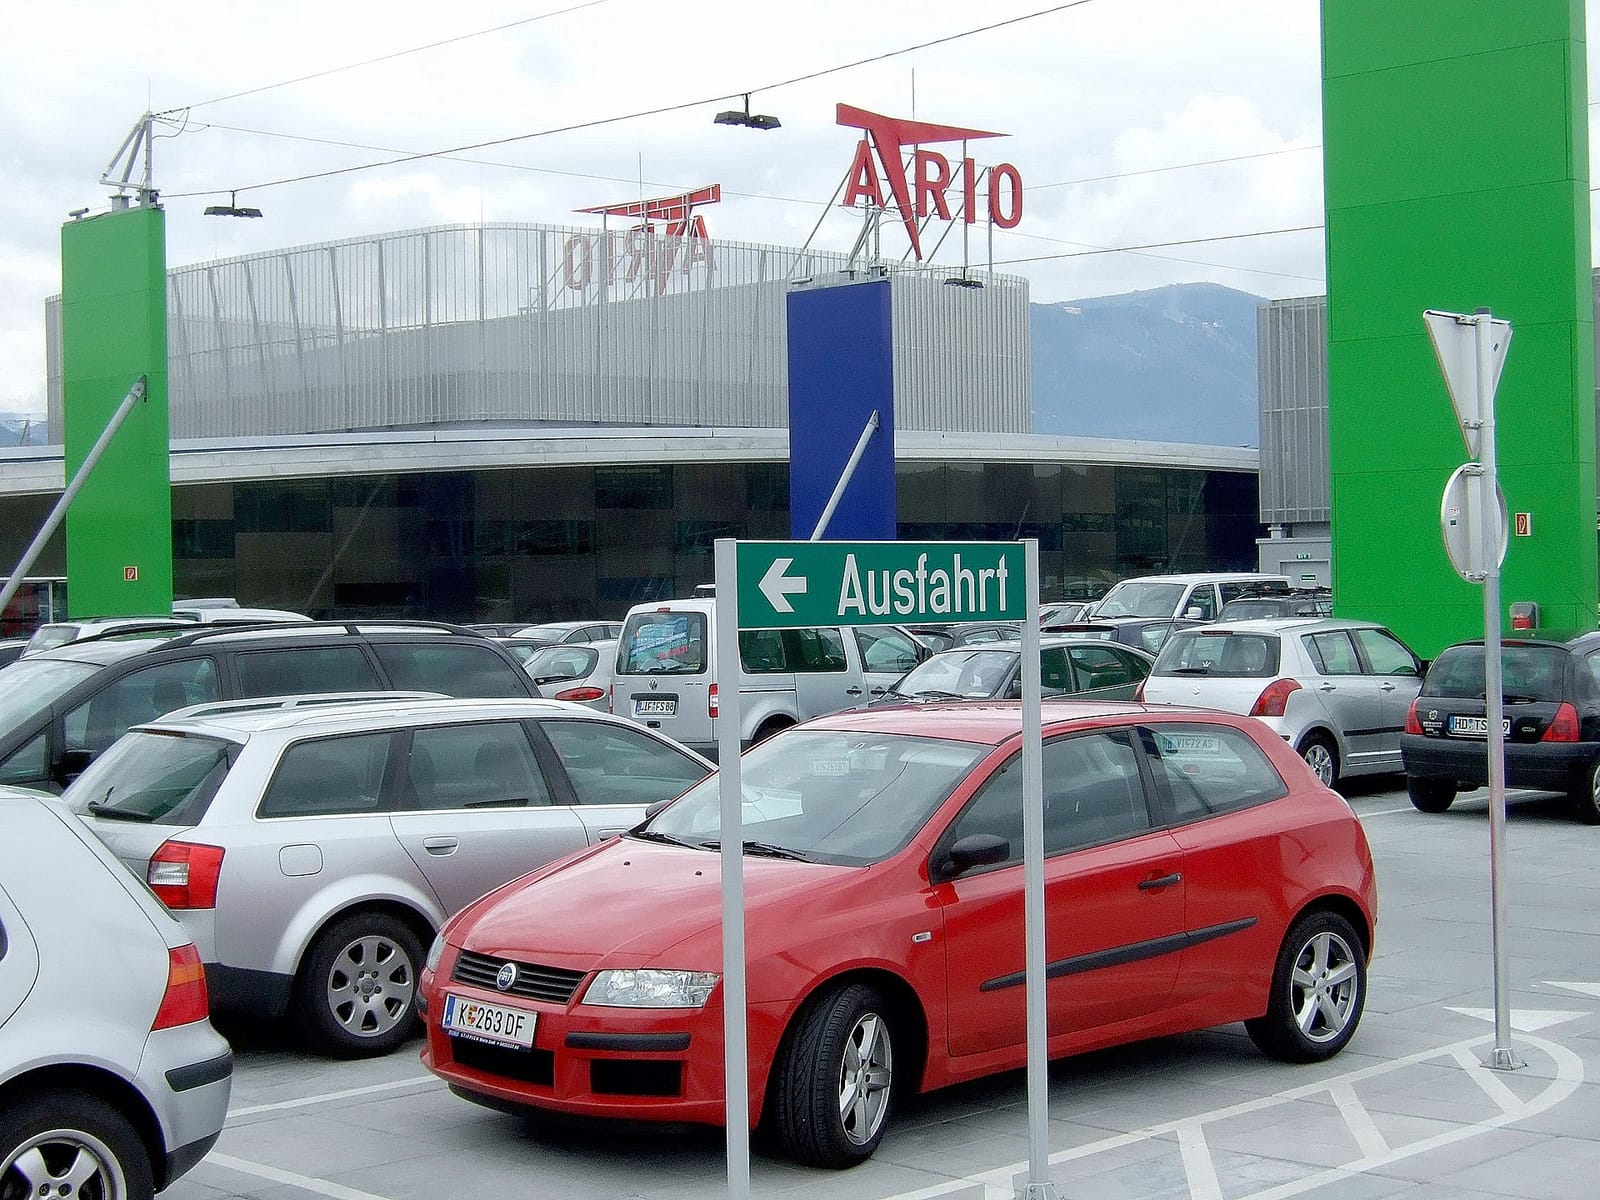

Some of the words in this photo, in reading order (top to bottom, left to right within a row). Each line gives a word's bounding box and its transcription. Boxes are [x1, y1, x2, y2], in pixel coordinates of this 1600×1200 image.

[836, 103, 1023, 260] ATRIO
[837, 552, 1009, 616] Ausfahrt
[1455, 718, 1468, 729] HD
[458, 1002, 469, 1026] K
[476, 1007, 503, 1033] 263
[505, 1013, 526, 1037] DF
